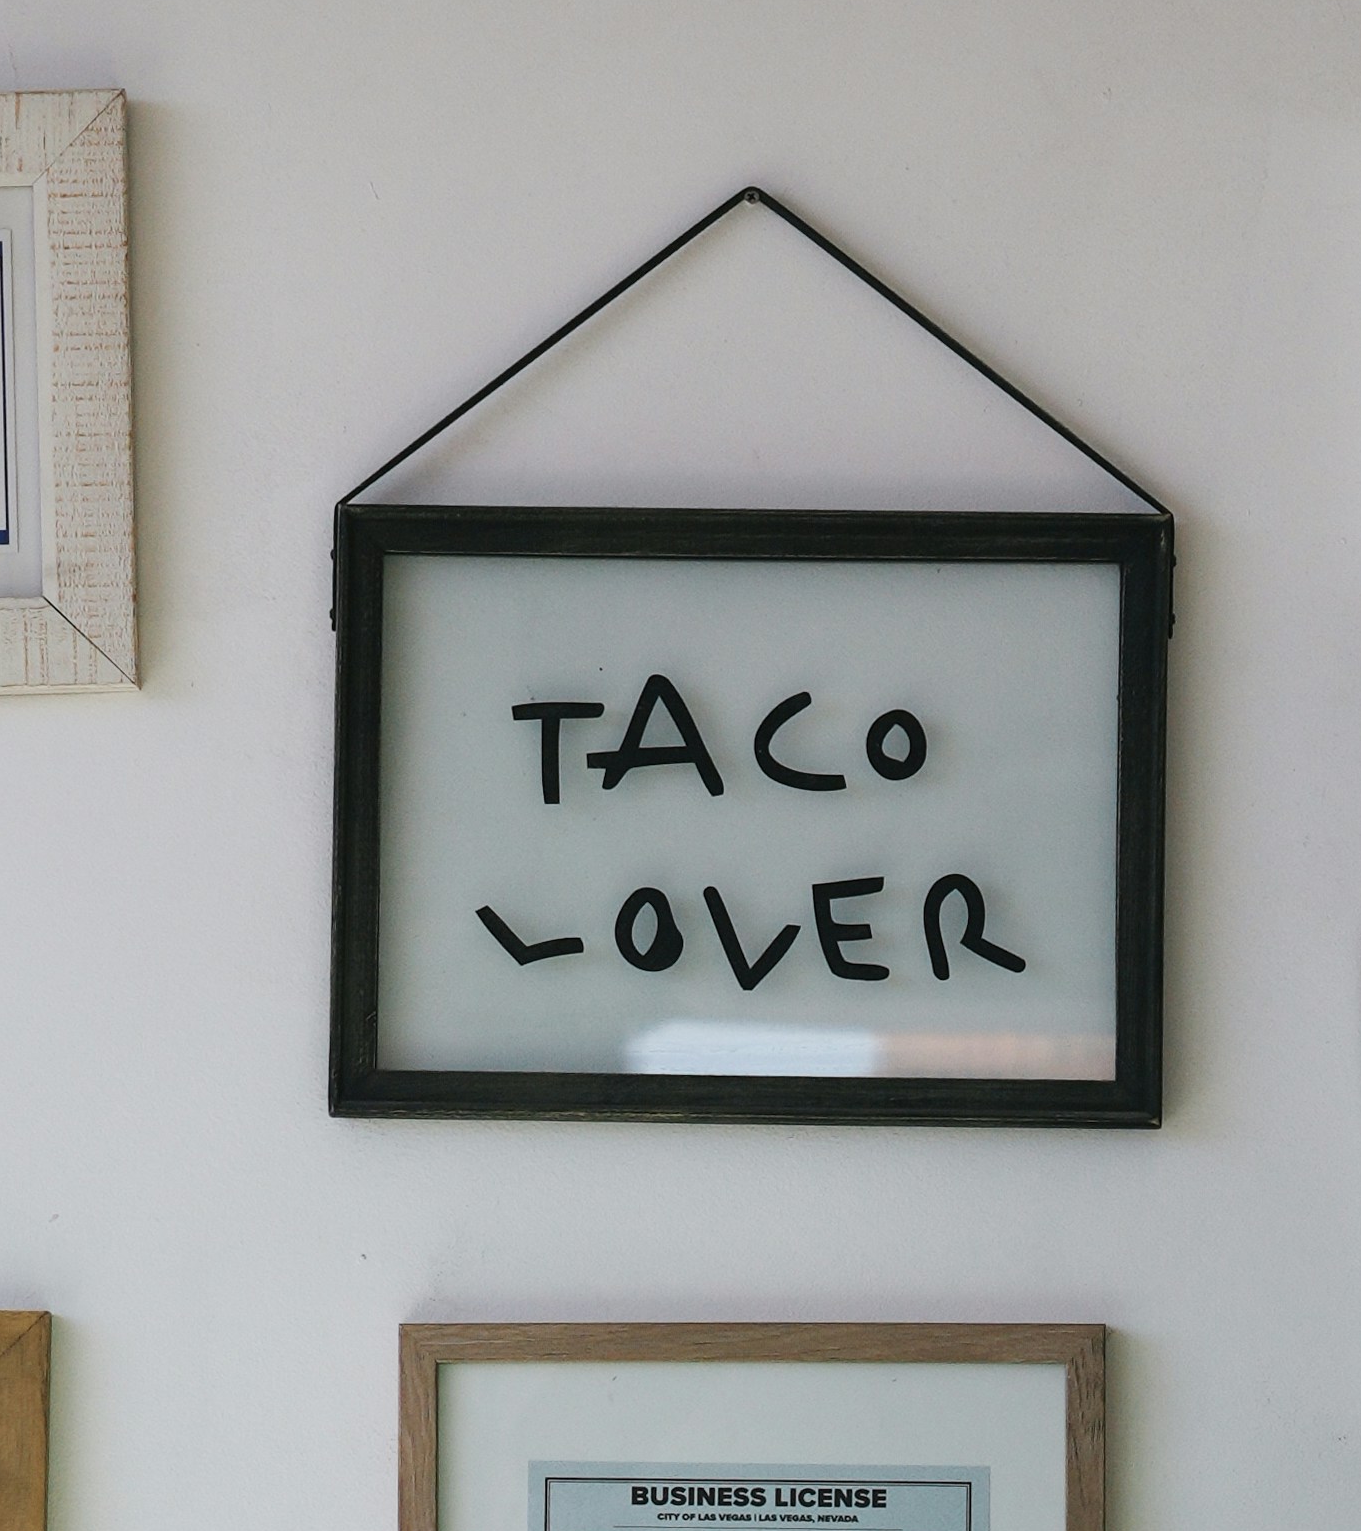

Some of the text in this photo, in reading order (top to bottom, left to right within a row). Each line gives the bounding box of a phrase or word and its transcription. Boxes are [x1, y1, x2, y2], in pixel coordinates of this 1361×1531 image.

[512, 674, 927, 804] TACO
[475, 874, 1026, 991] LOVER
[632, 1486, 886, 1508] BUSINESS LICENSE
[656, 1512, 859, 1524] CITY OF LAS VEGAS LAS VEGAS, NEVADA
